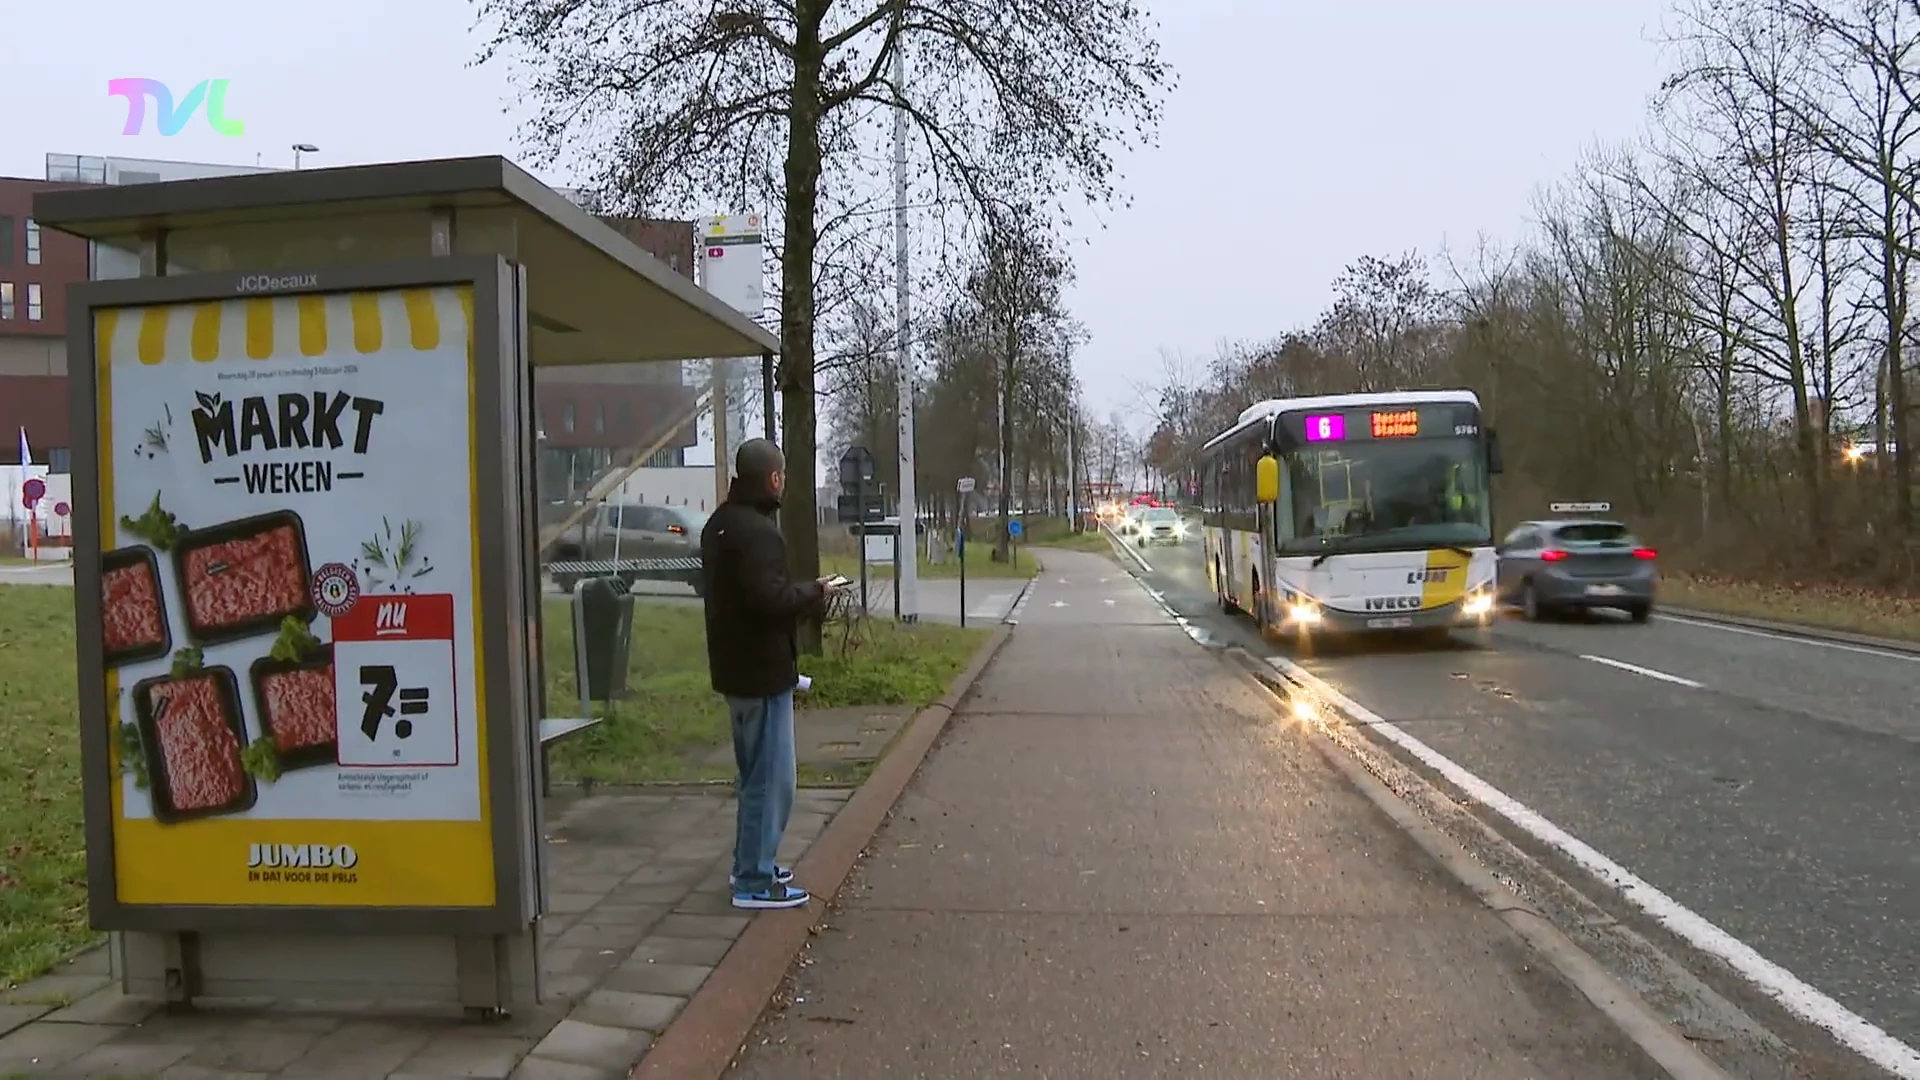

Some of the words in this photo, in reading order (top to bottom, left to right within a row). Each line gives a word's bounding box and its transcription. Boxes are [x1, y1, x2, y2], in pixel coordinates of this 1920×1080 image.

[236, 274, 318, 292] JCDecaux
[191, 389, 384, 464] MARKT
[1319, 416, 1331, 438] 6
[243, 461, 331, 494] WEKEN
[1365, 596, 1421, 610] IVECO
[247, 843, 358, 870] JUMBO
[248, 871, 260, 883] EN
[262, 871, 281, 883] DAT
[284, 871, 312, 883] VOOR
[314, 872, 330, 883] DIE
[332, 872, 358, 884] PRIJS
